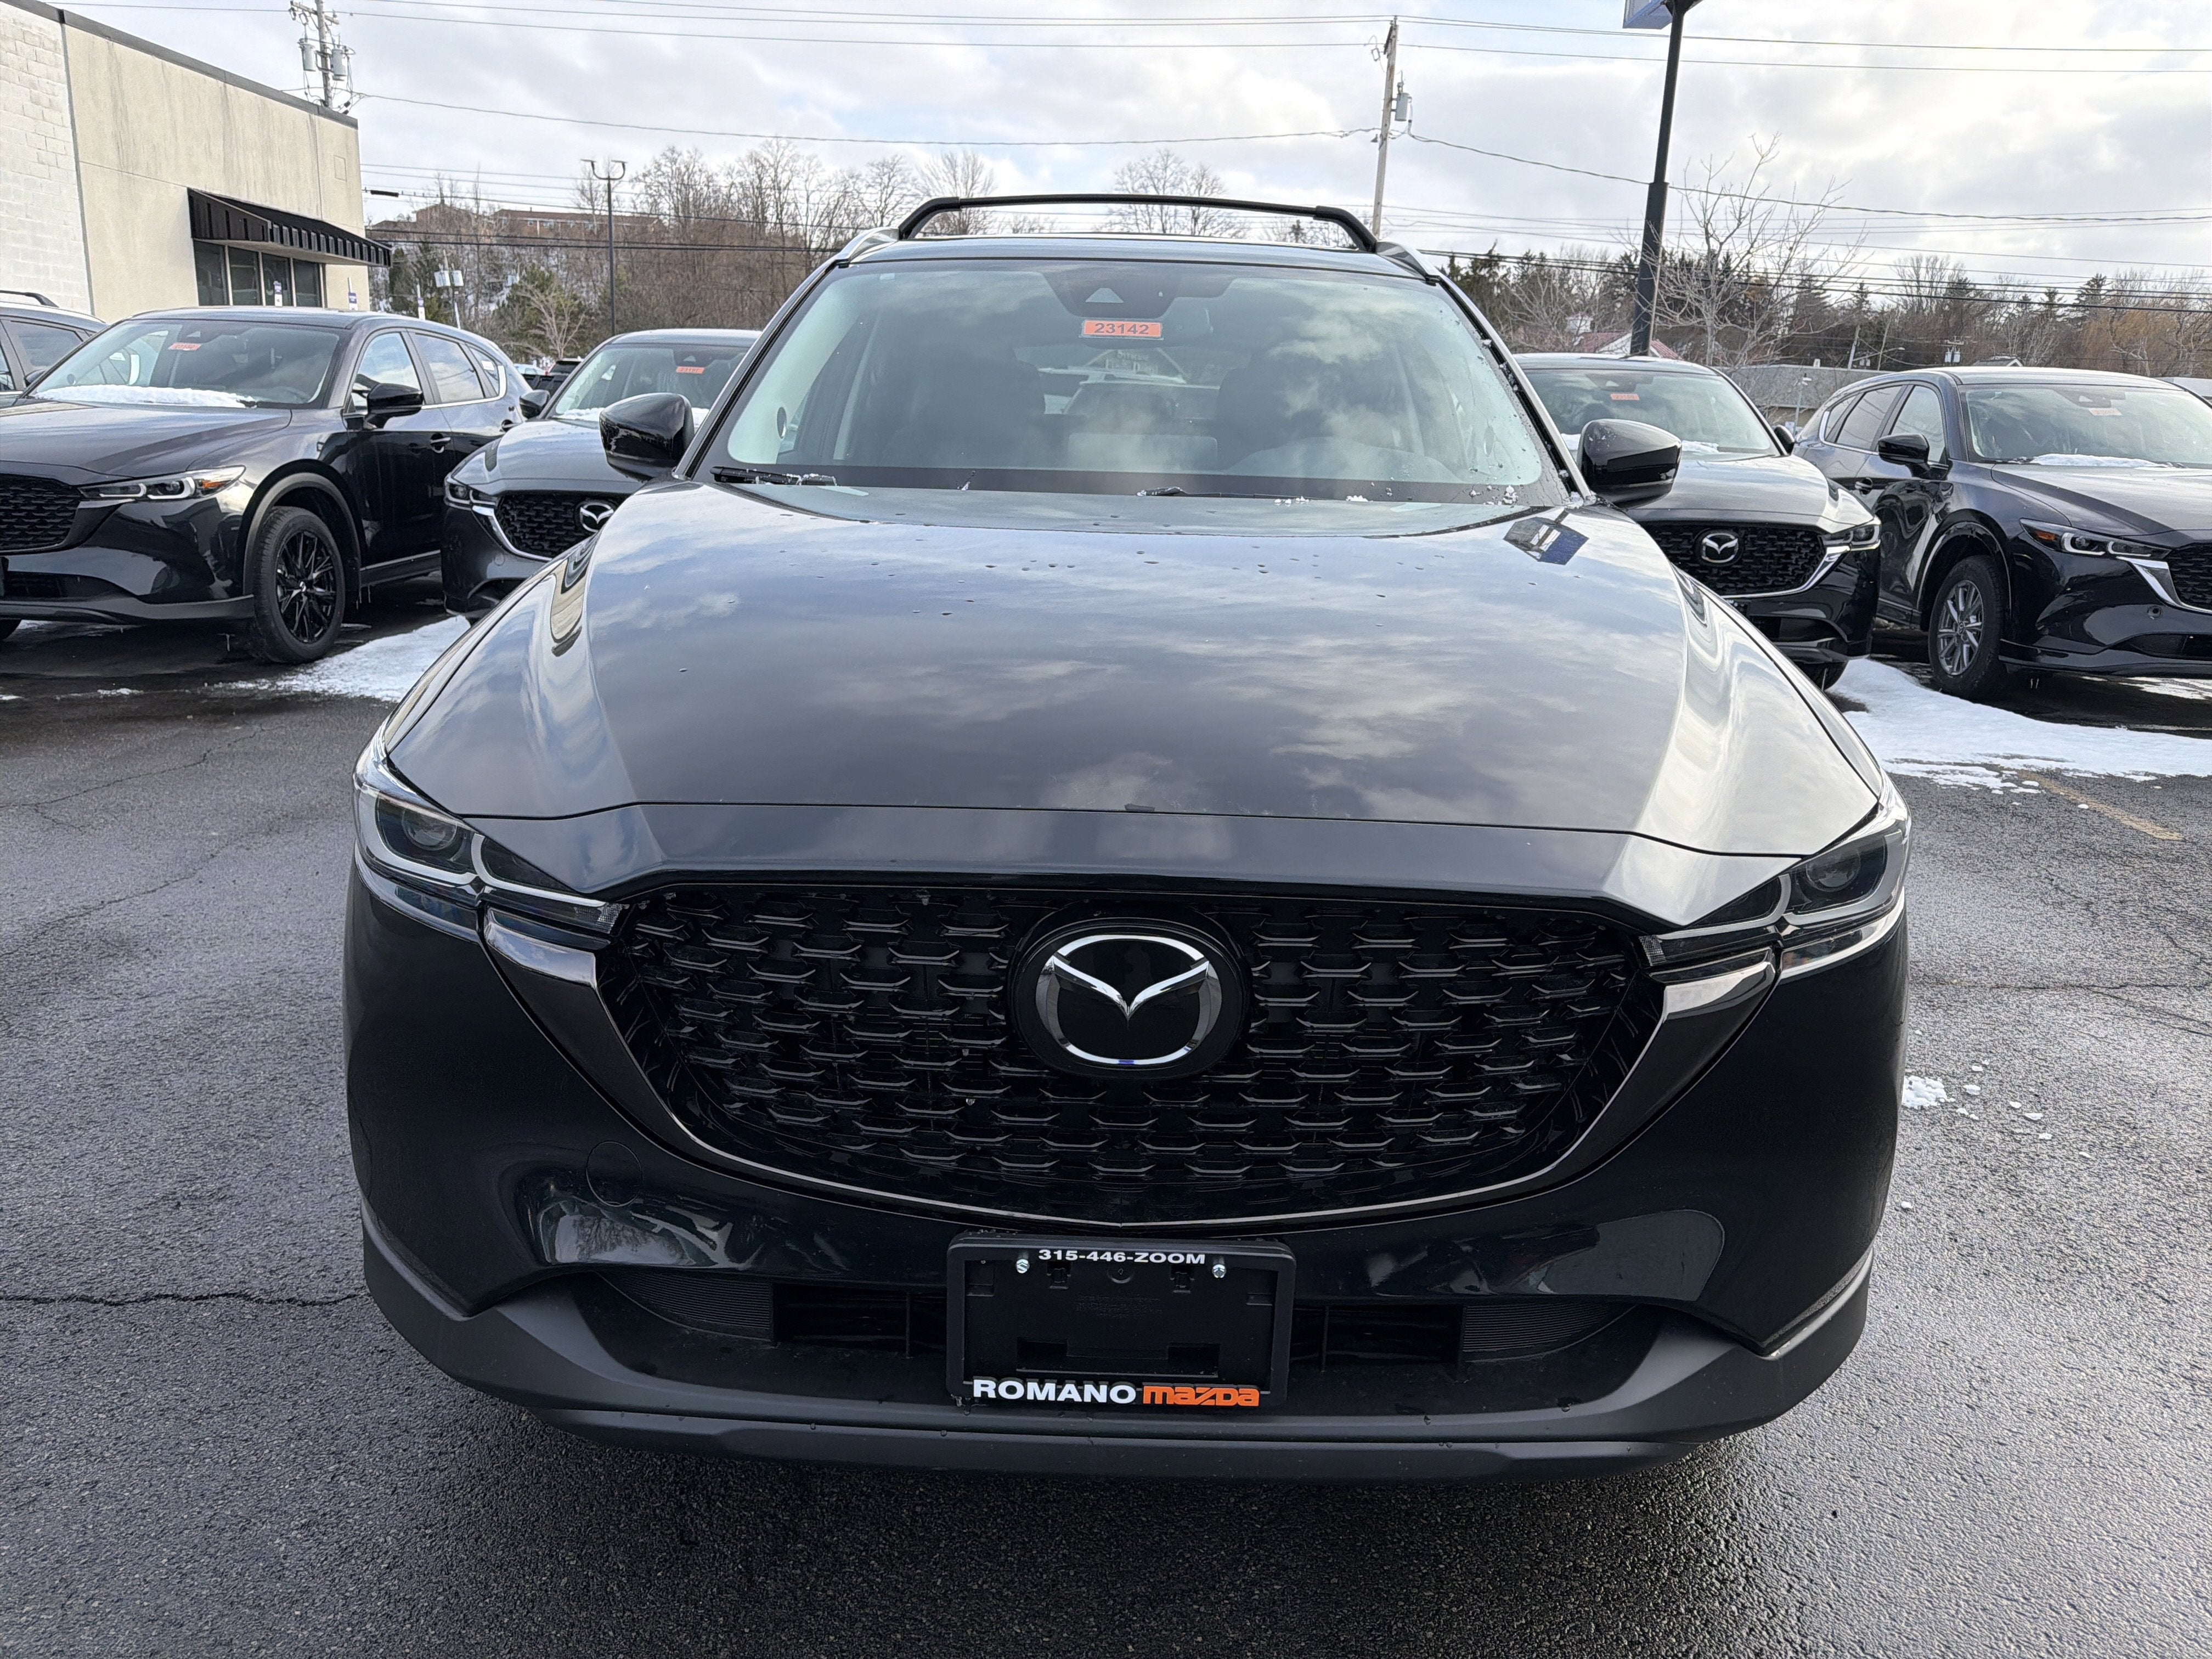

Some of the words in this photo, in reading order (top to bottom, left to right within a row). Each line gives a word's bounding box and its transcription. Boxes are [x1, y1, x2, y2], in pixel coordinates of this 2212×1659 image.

[1094, 323, 1149, 335] 23142
[1039, 1249, 1205, 1265] 315-446-ZOOM
[973, 1379, 1136, 1404] ROMANO
